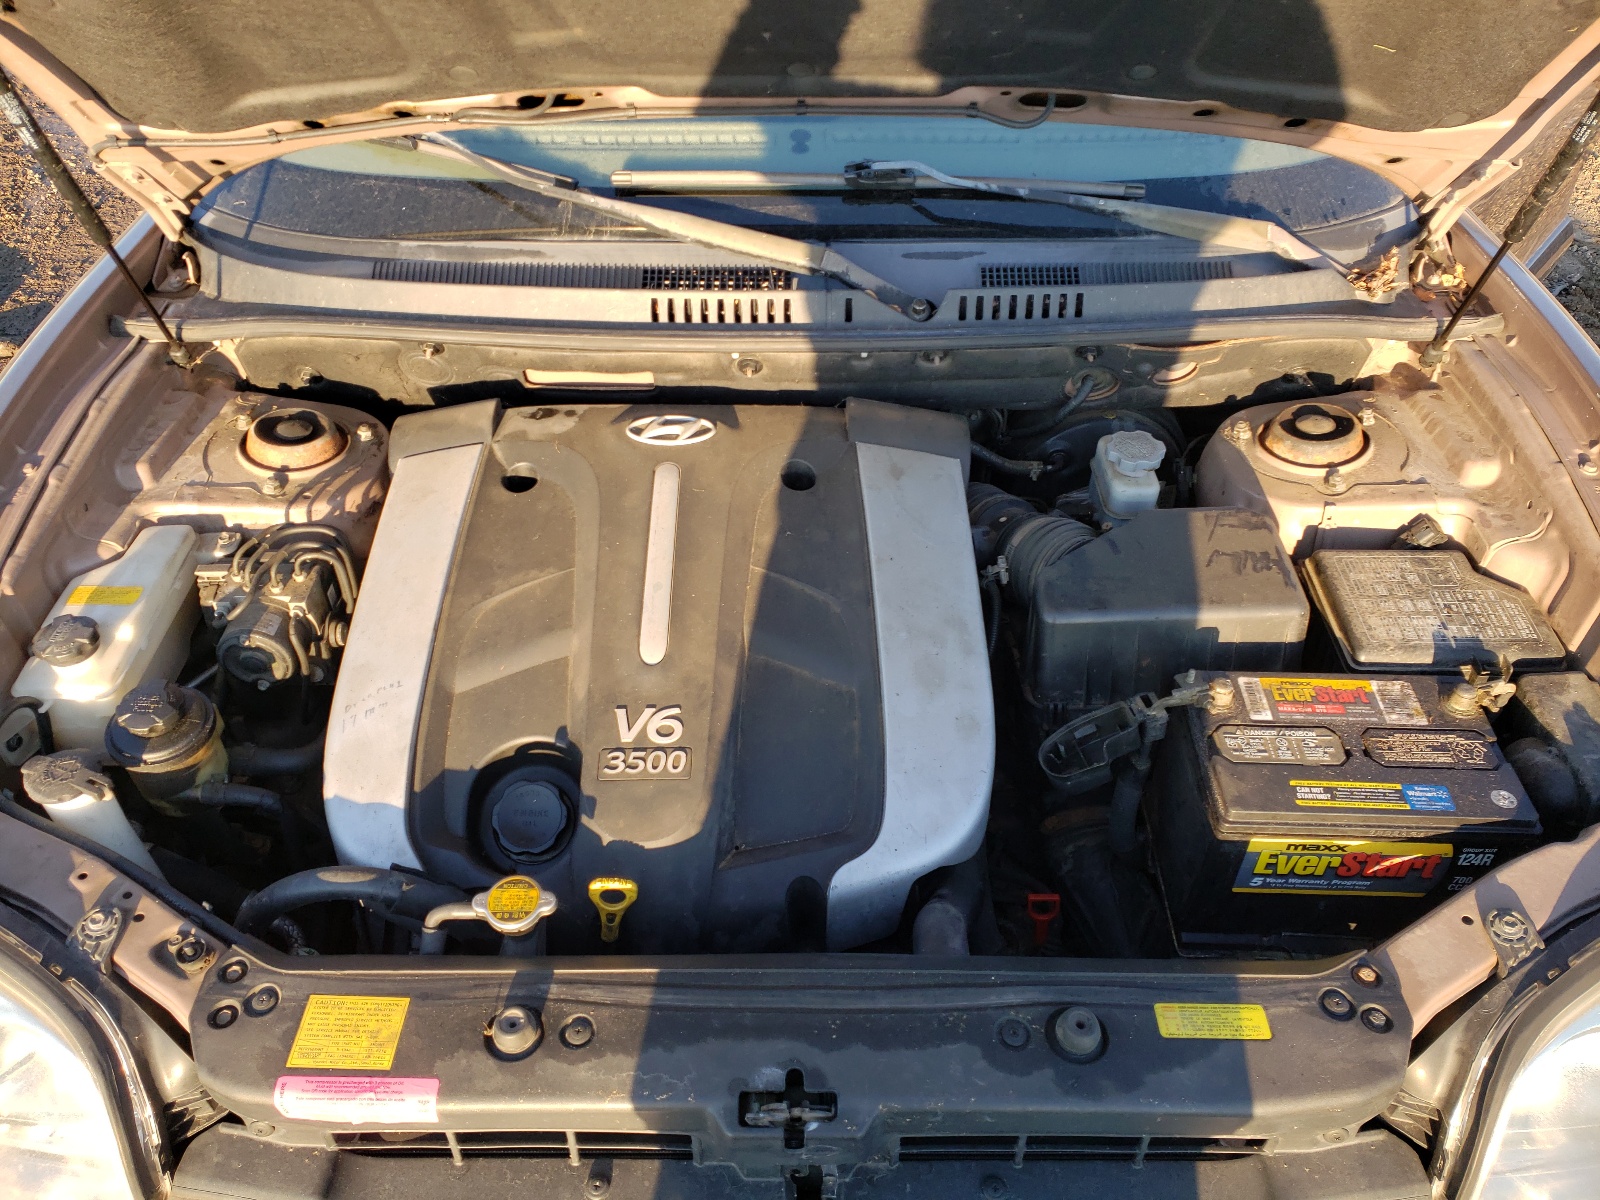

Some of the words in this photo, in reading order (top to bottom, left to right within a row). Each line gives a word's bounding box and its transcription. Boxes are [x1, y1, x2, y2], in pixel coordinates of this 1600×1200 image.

[1270, 684, 1370, 704] EverStart
[614, 705, 683, 744] V6
[603, 749, 688, 774] 3500
[1286, 843, 1350, 852] maxx
[1253, 850, 1442, 878] EverStart
[1457, 853, 1495, 866] 124R
[1249, 877, 1265, 887] 5
[1288, 878, 1329, 886] Warranty
[1452, 876, 1474, 884] 700
